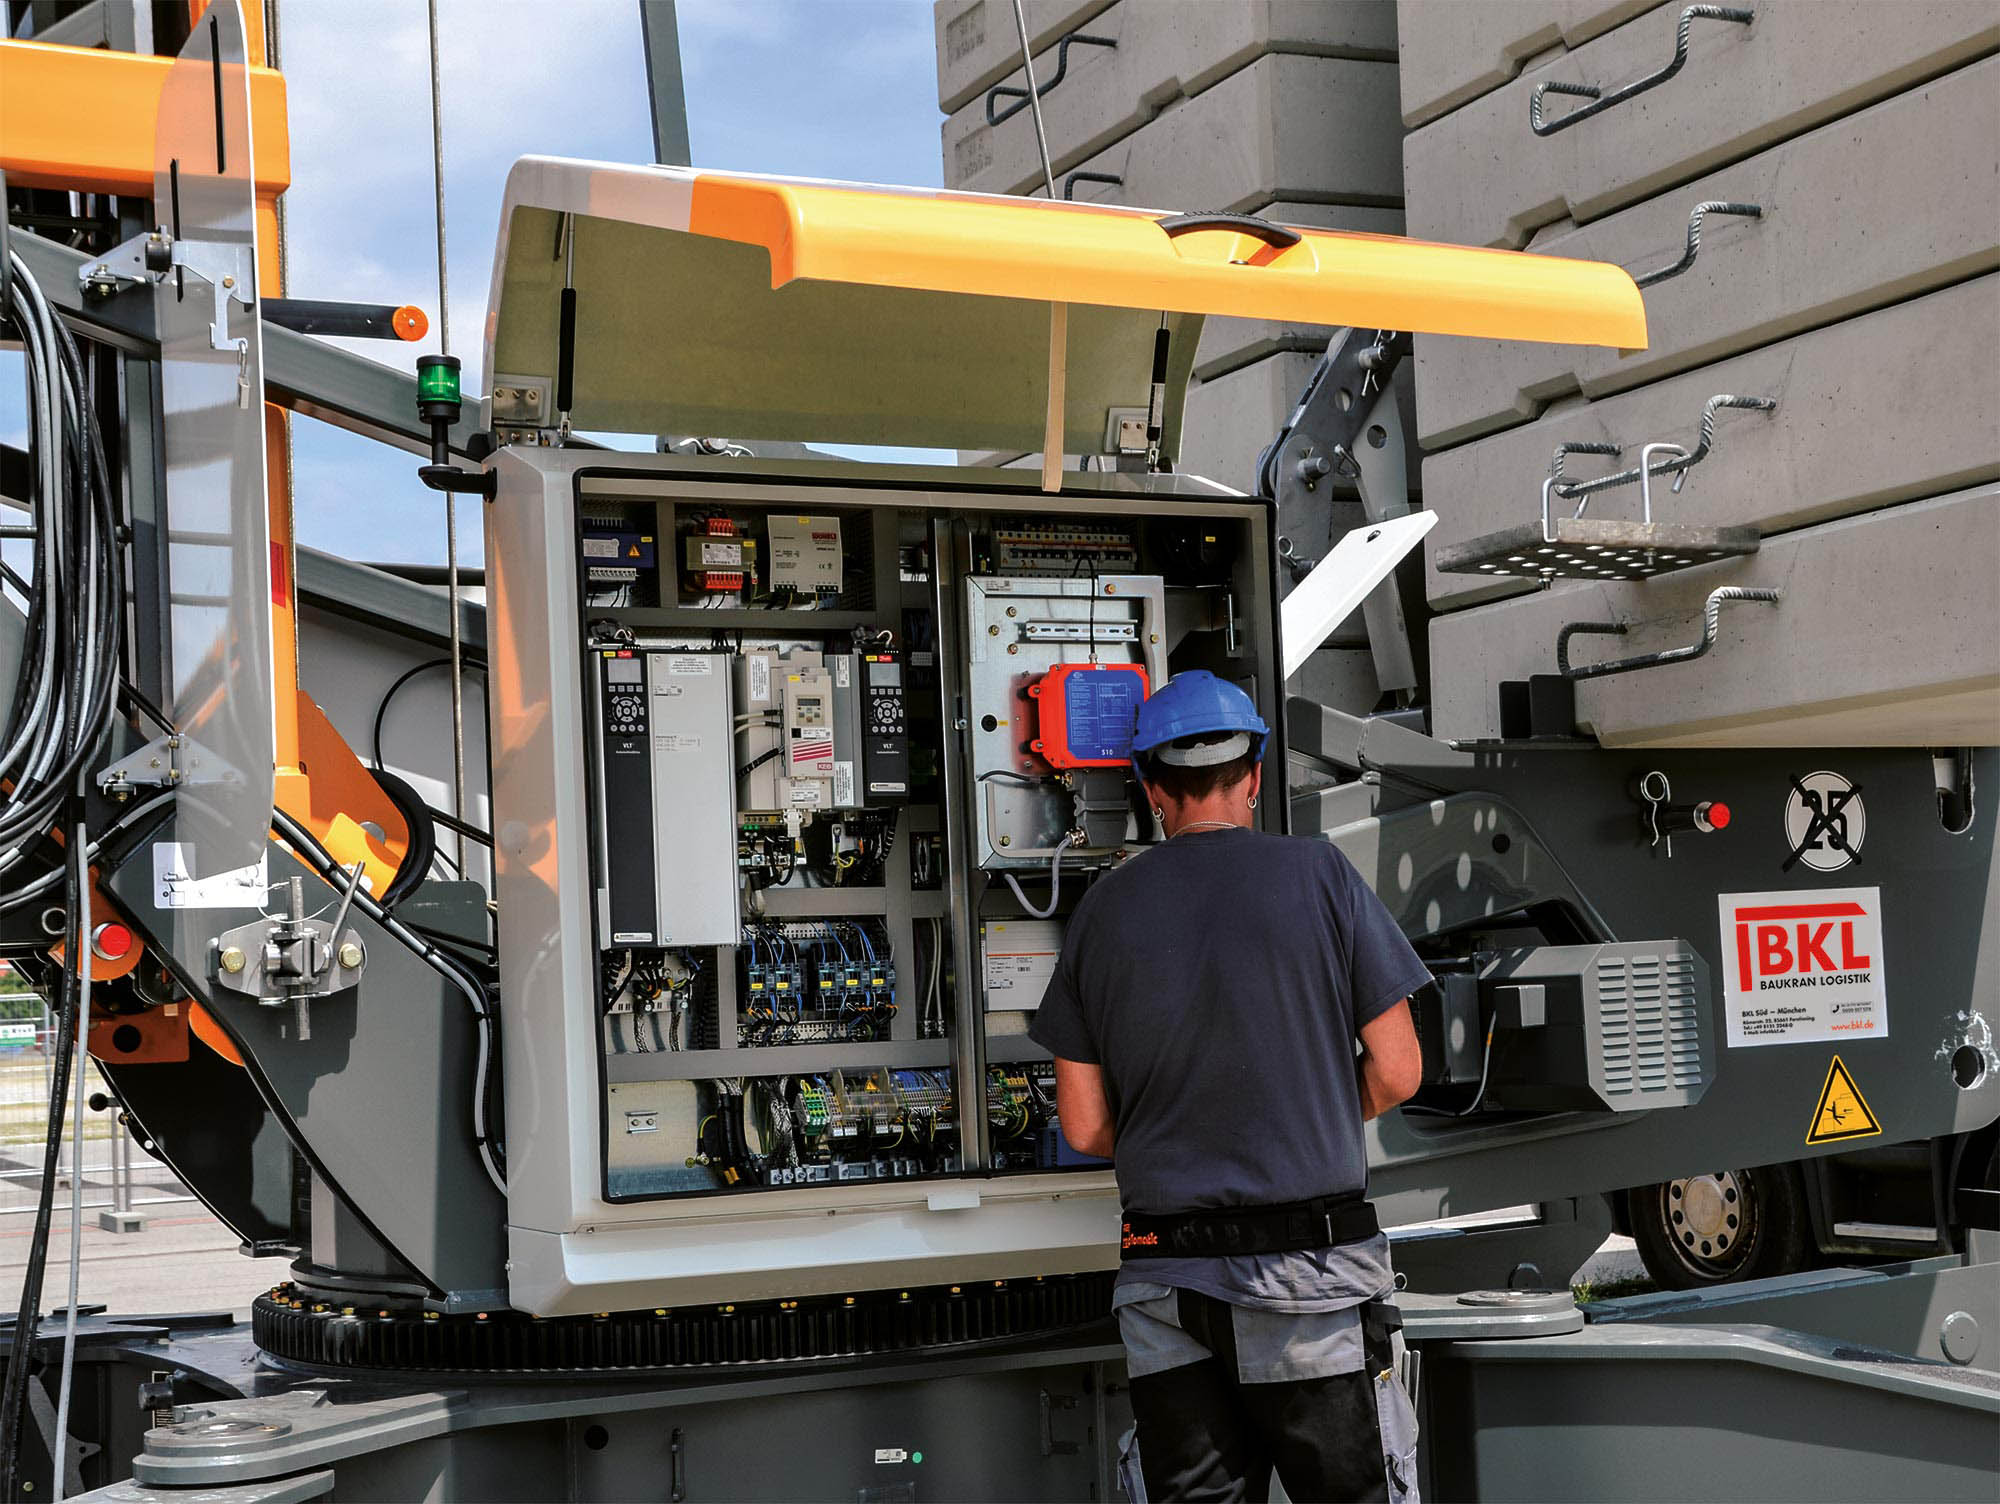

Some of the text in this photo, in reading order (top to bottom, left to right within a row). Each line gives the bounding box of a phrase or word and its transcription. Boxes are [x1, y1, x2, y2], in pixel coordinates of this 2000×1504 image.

[1757, 921, 1870, 975] BKL
[1760, 973, 1871, 990] BAUKRAN LOGISTIK
[1755, 1008, 1768, 1016] Süd
[1777, 1006, 1807, 1015] München
[1832, 1019, 1874, 1030] www.bkl.de
